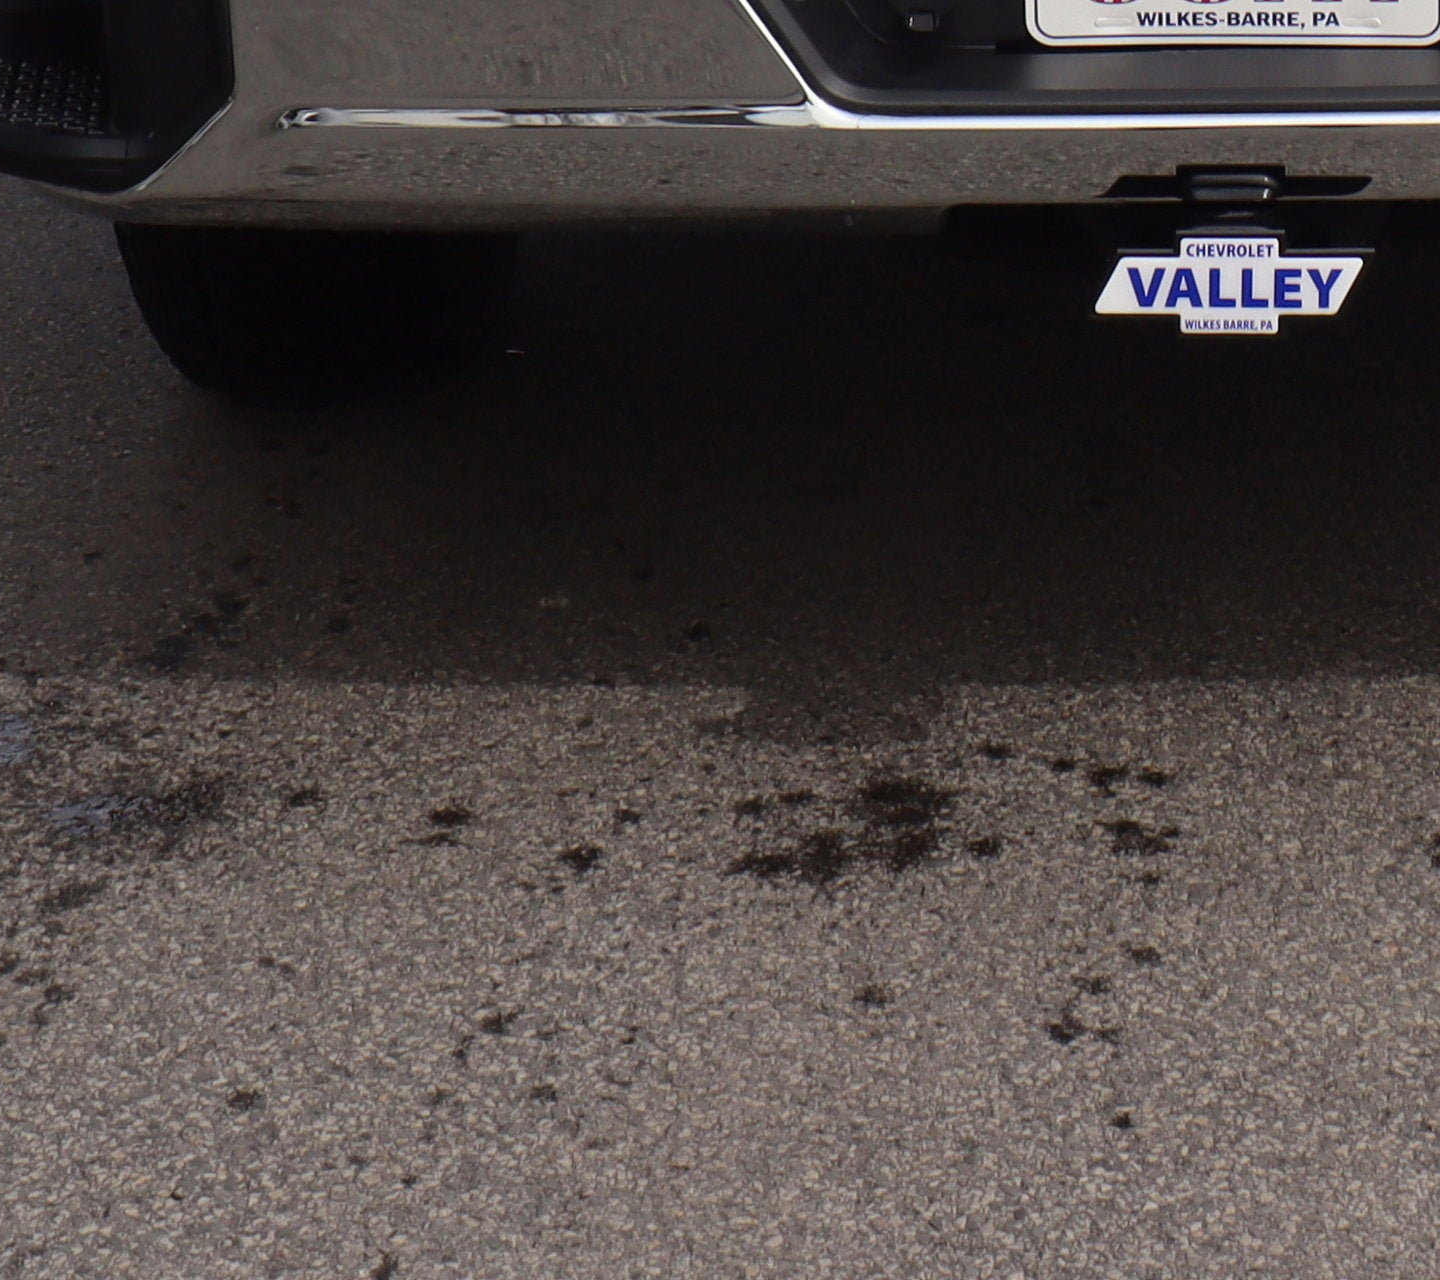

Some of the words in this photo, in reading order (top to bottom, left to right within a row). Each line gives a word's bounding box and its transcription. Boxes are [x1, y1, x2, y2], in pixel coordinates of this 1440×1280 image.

[1137, 11, 1306, 30] WILKES-BARRE,
[1312, 12, 1340, 28] PA
[1186, 244, 1274, 258] CHEVROLET
[1127, 268, 1344, 309] VALLEY
[1185, 319, 1221, 330] WILKES
[1223, 319, 1258, 331] BARRE,
[1260, 320, 1273, 330] PA
